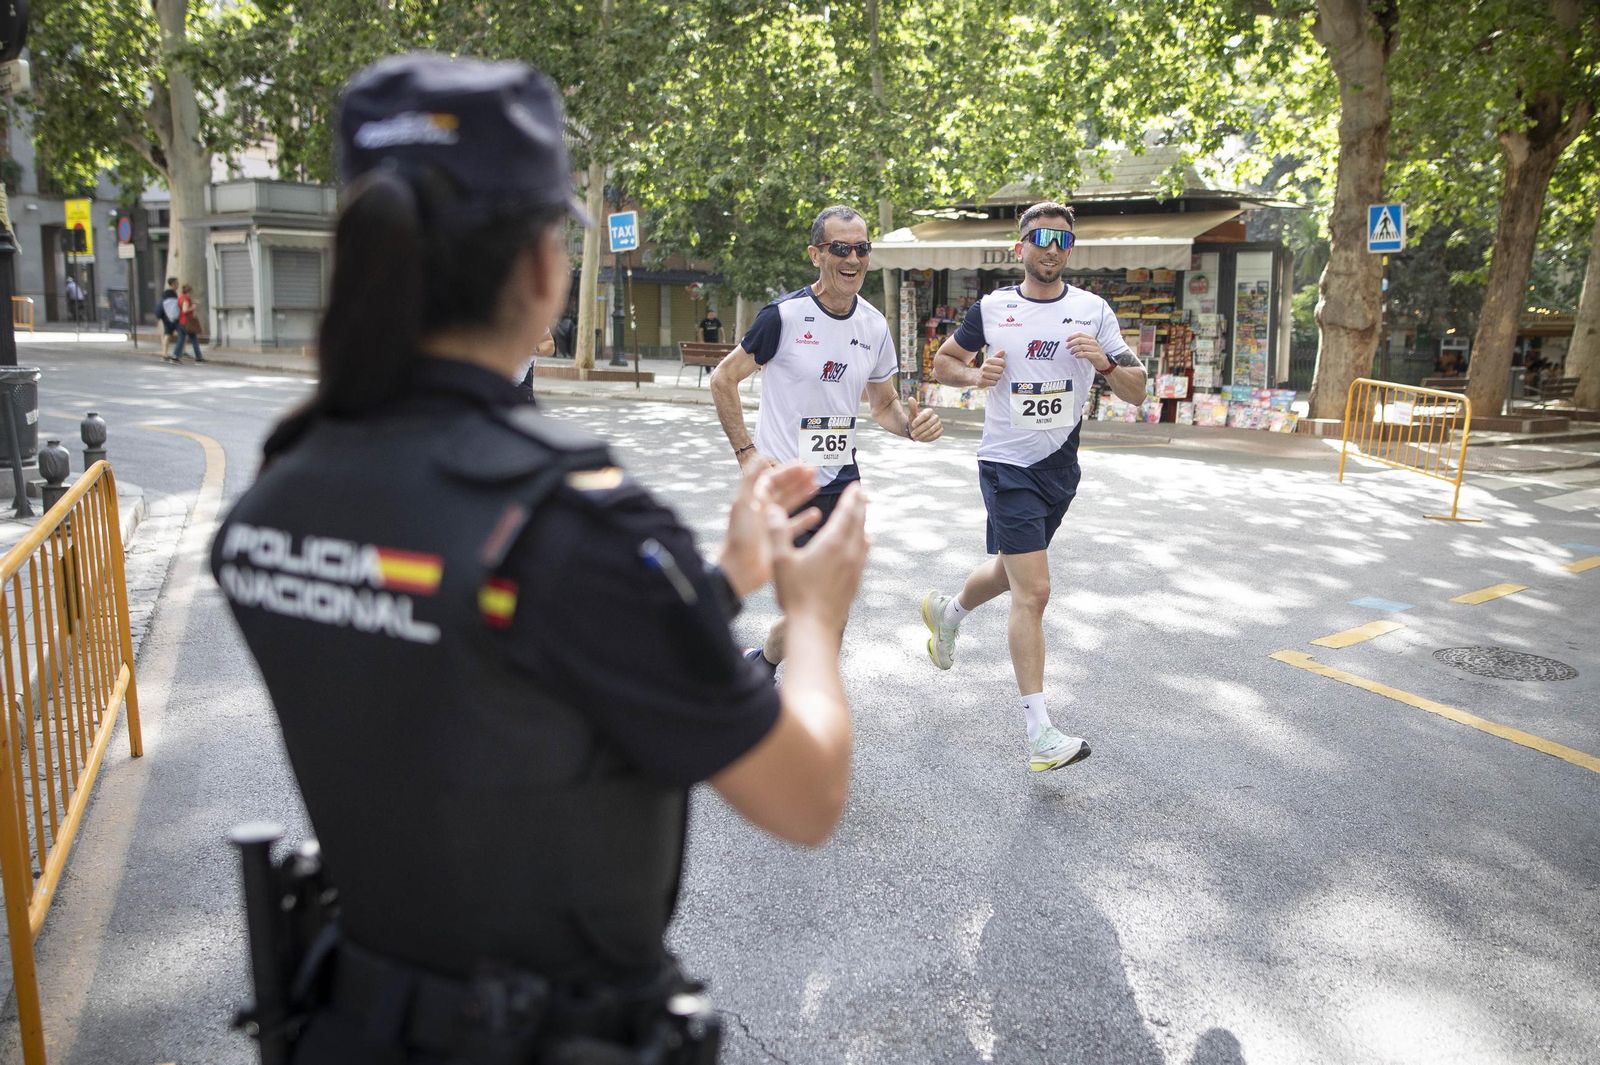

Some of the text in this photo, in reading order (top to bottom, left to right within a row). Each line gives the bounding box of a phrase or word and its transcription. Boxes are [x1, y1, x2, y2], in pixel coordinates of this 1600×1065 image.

[611, 225, 635, 239] TAXI
[983, 249, 1023, 264] IDE
[1022, 398, 1062, 416] 266
[811, 434, 848, 452] 265
[220, 564, 441, 644] NACIONAL
